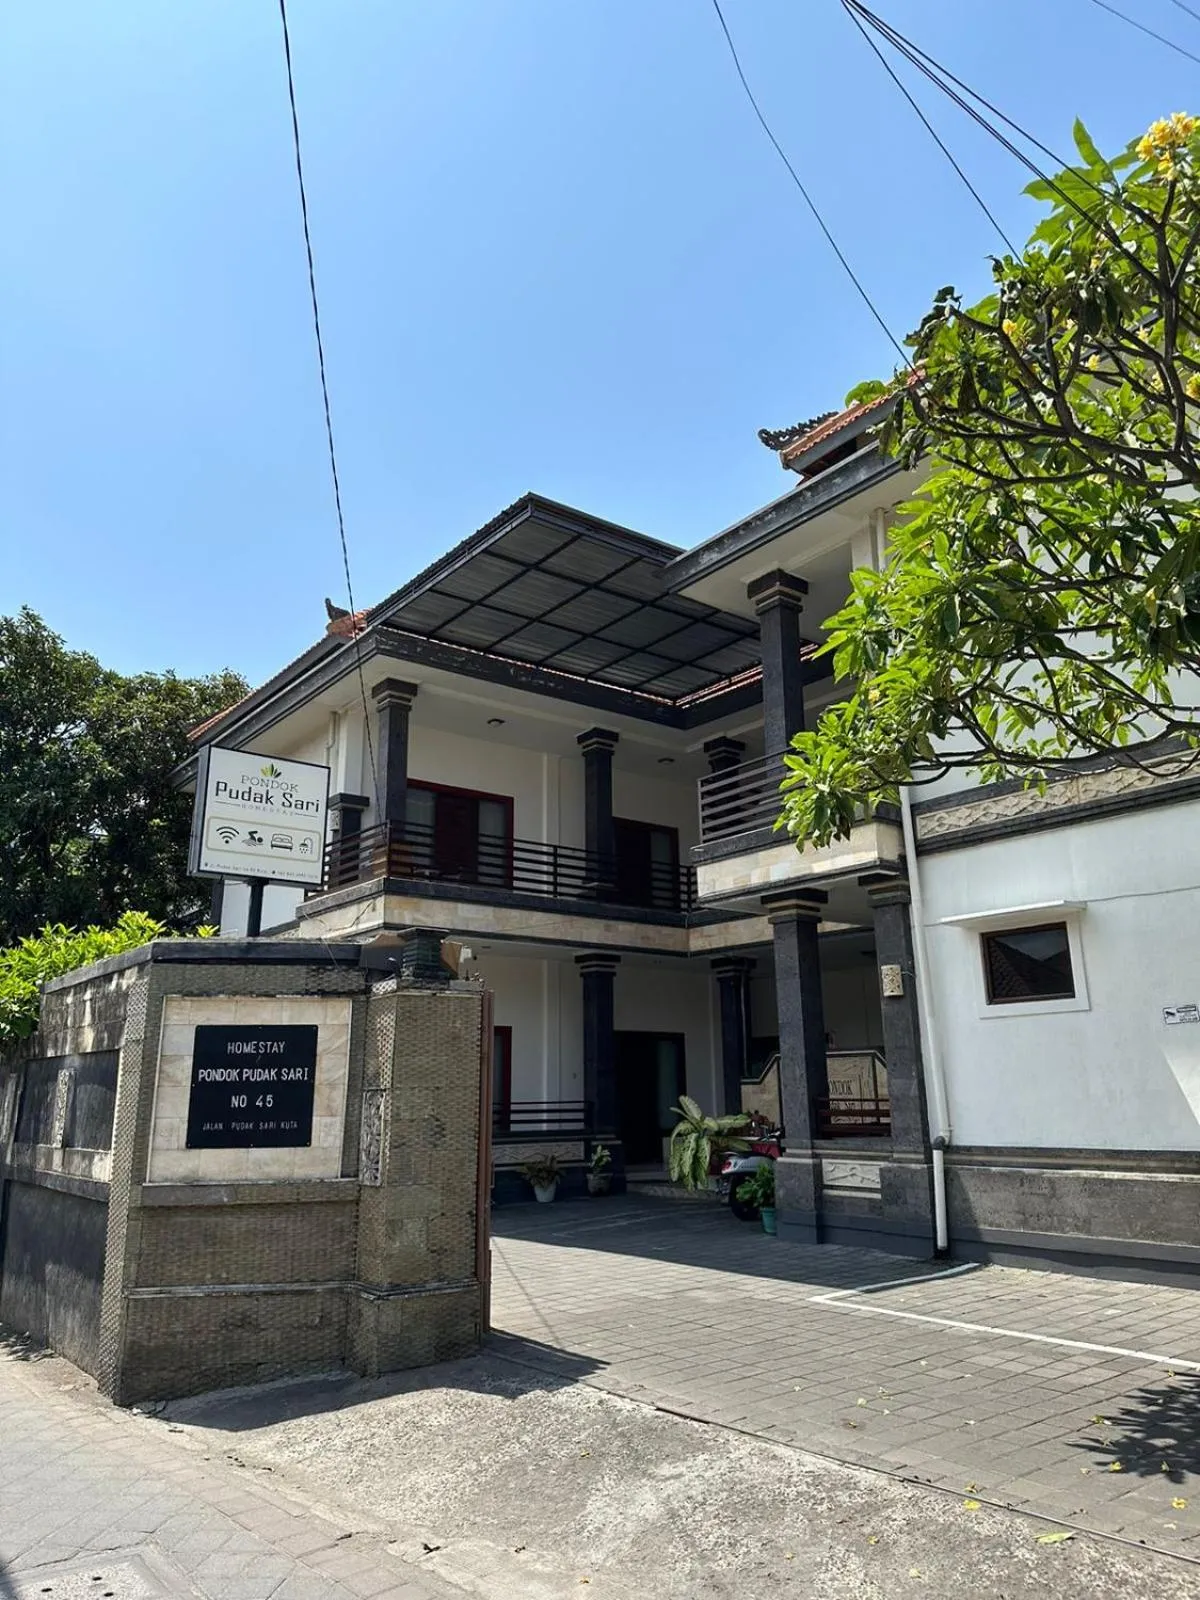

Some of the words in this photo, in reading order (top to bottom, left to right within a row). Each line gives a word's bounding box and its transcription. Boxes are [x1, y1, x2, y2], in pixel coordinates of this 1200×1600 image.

[241, 774, 299, 793] PONDOK
[215, 780, 274, 806] Pudak
[281, 792, 320, 813] Sari
[227, 1040, 286, 1055] HOMESTAY
[198, 1068, 240, 1083] PONDOK
[242, 1068, 279, 1082] PUDAK
[280, 1067, 309, 1081] SARI
[230, 1094, 247, 1109] NO
[255, 1093, 274, 1108] 45
[203, 1121, 223, 1130] JALAN
[231, 1121, 253, 1130] PUDAK
[259, 1121, 276, 1130] SARI
[281, 1120, 298, 1129] KUTA
